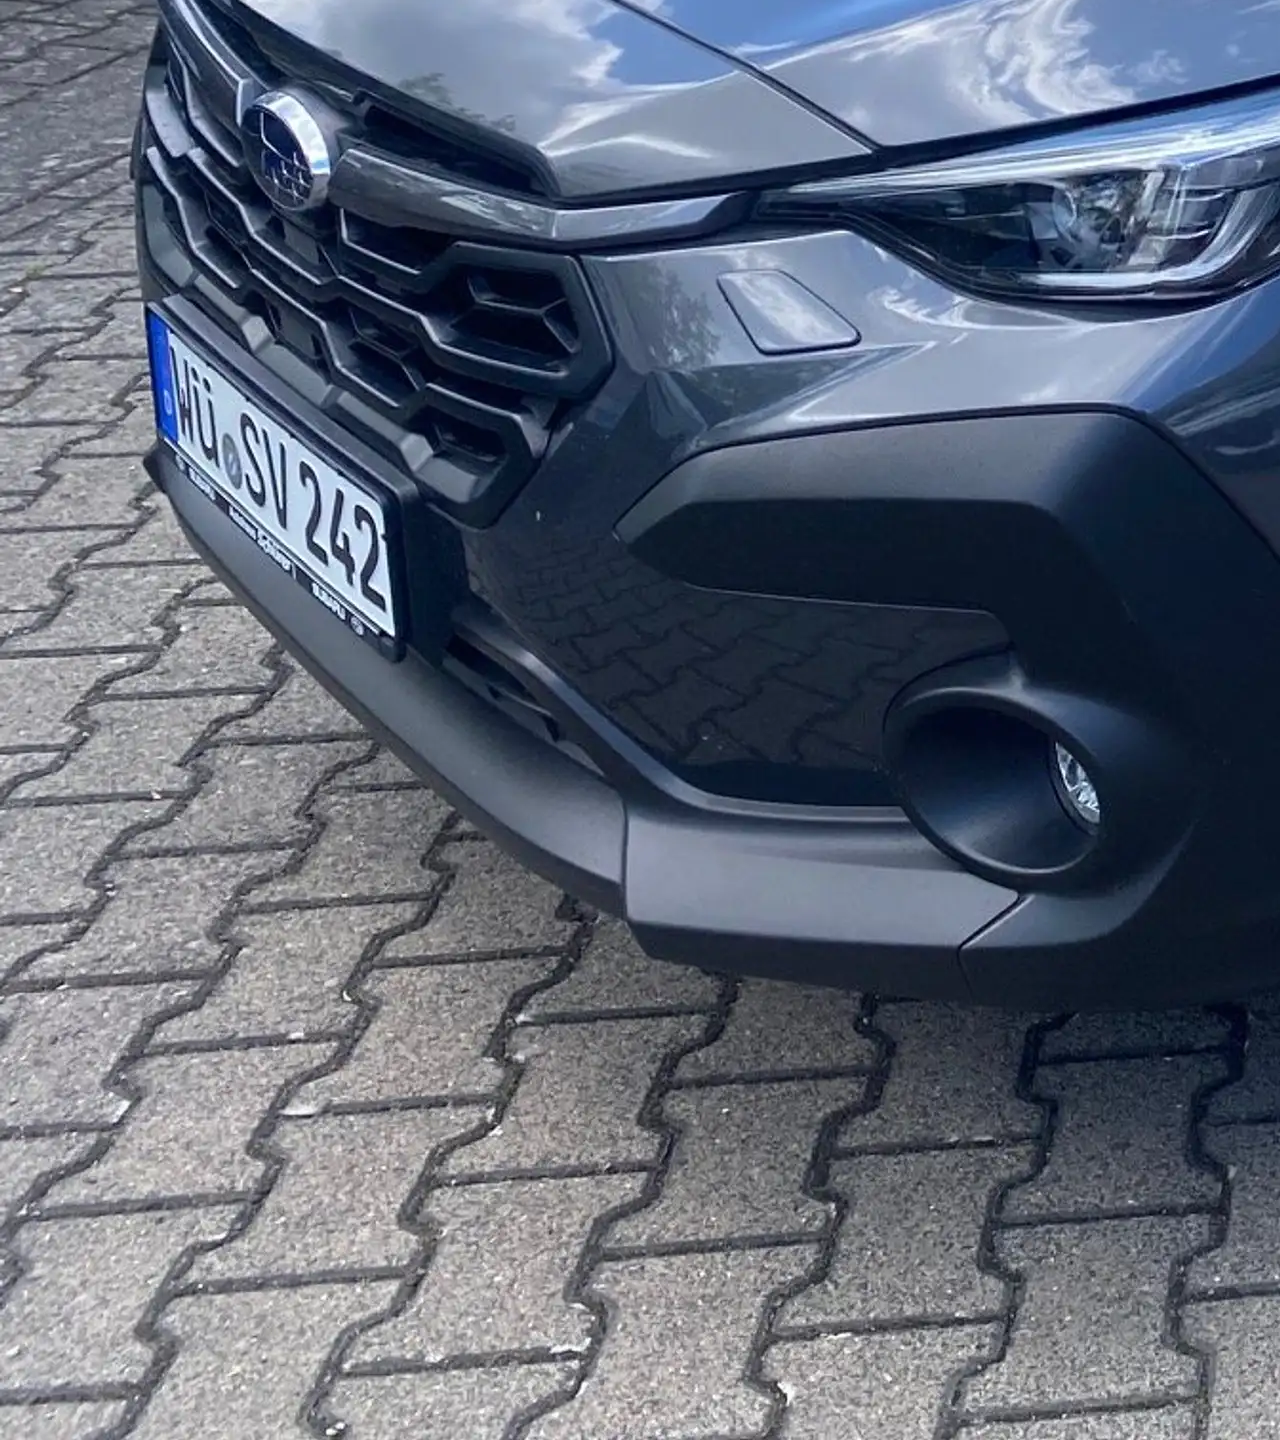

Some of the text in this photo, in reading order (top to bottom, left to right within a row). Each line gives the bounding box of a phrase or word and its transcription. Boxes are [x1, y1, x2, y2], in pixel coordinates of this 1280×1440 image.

[170, 346, 220, 468] WÜ
[240, 412, 289, 530] SV
[300, 460, 387, 613] 242
